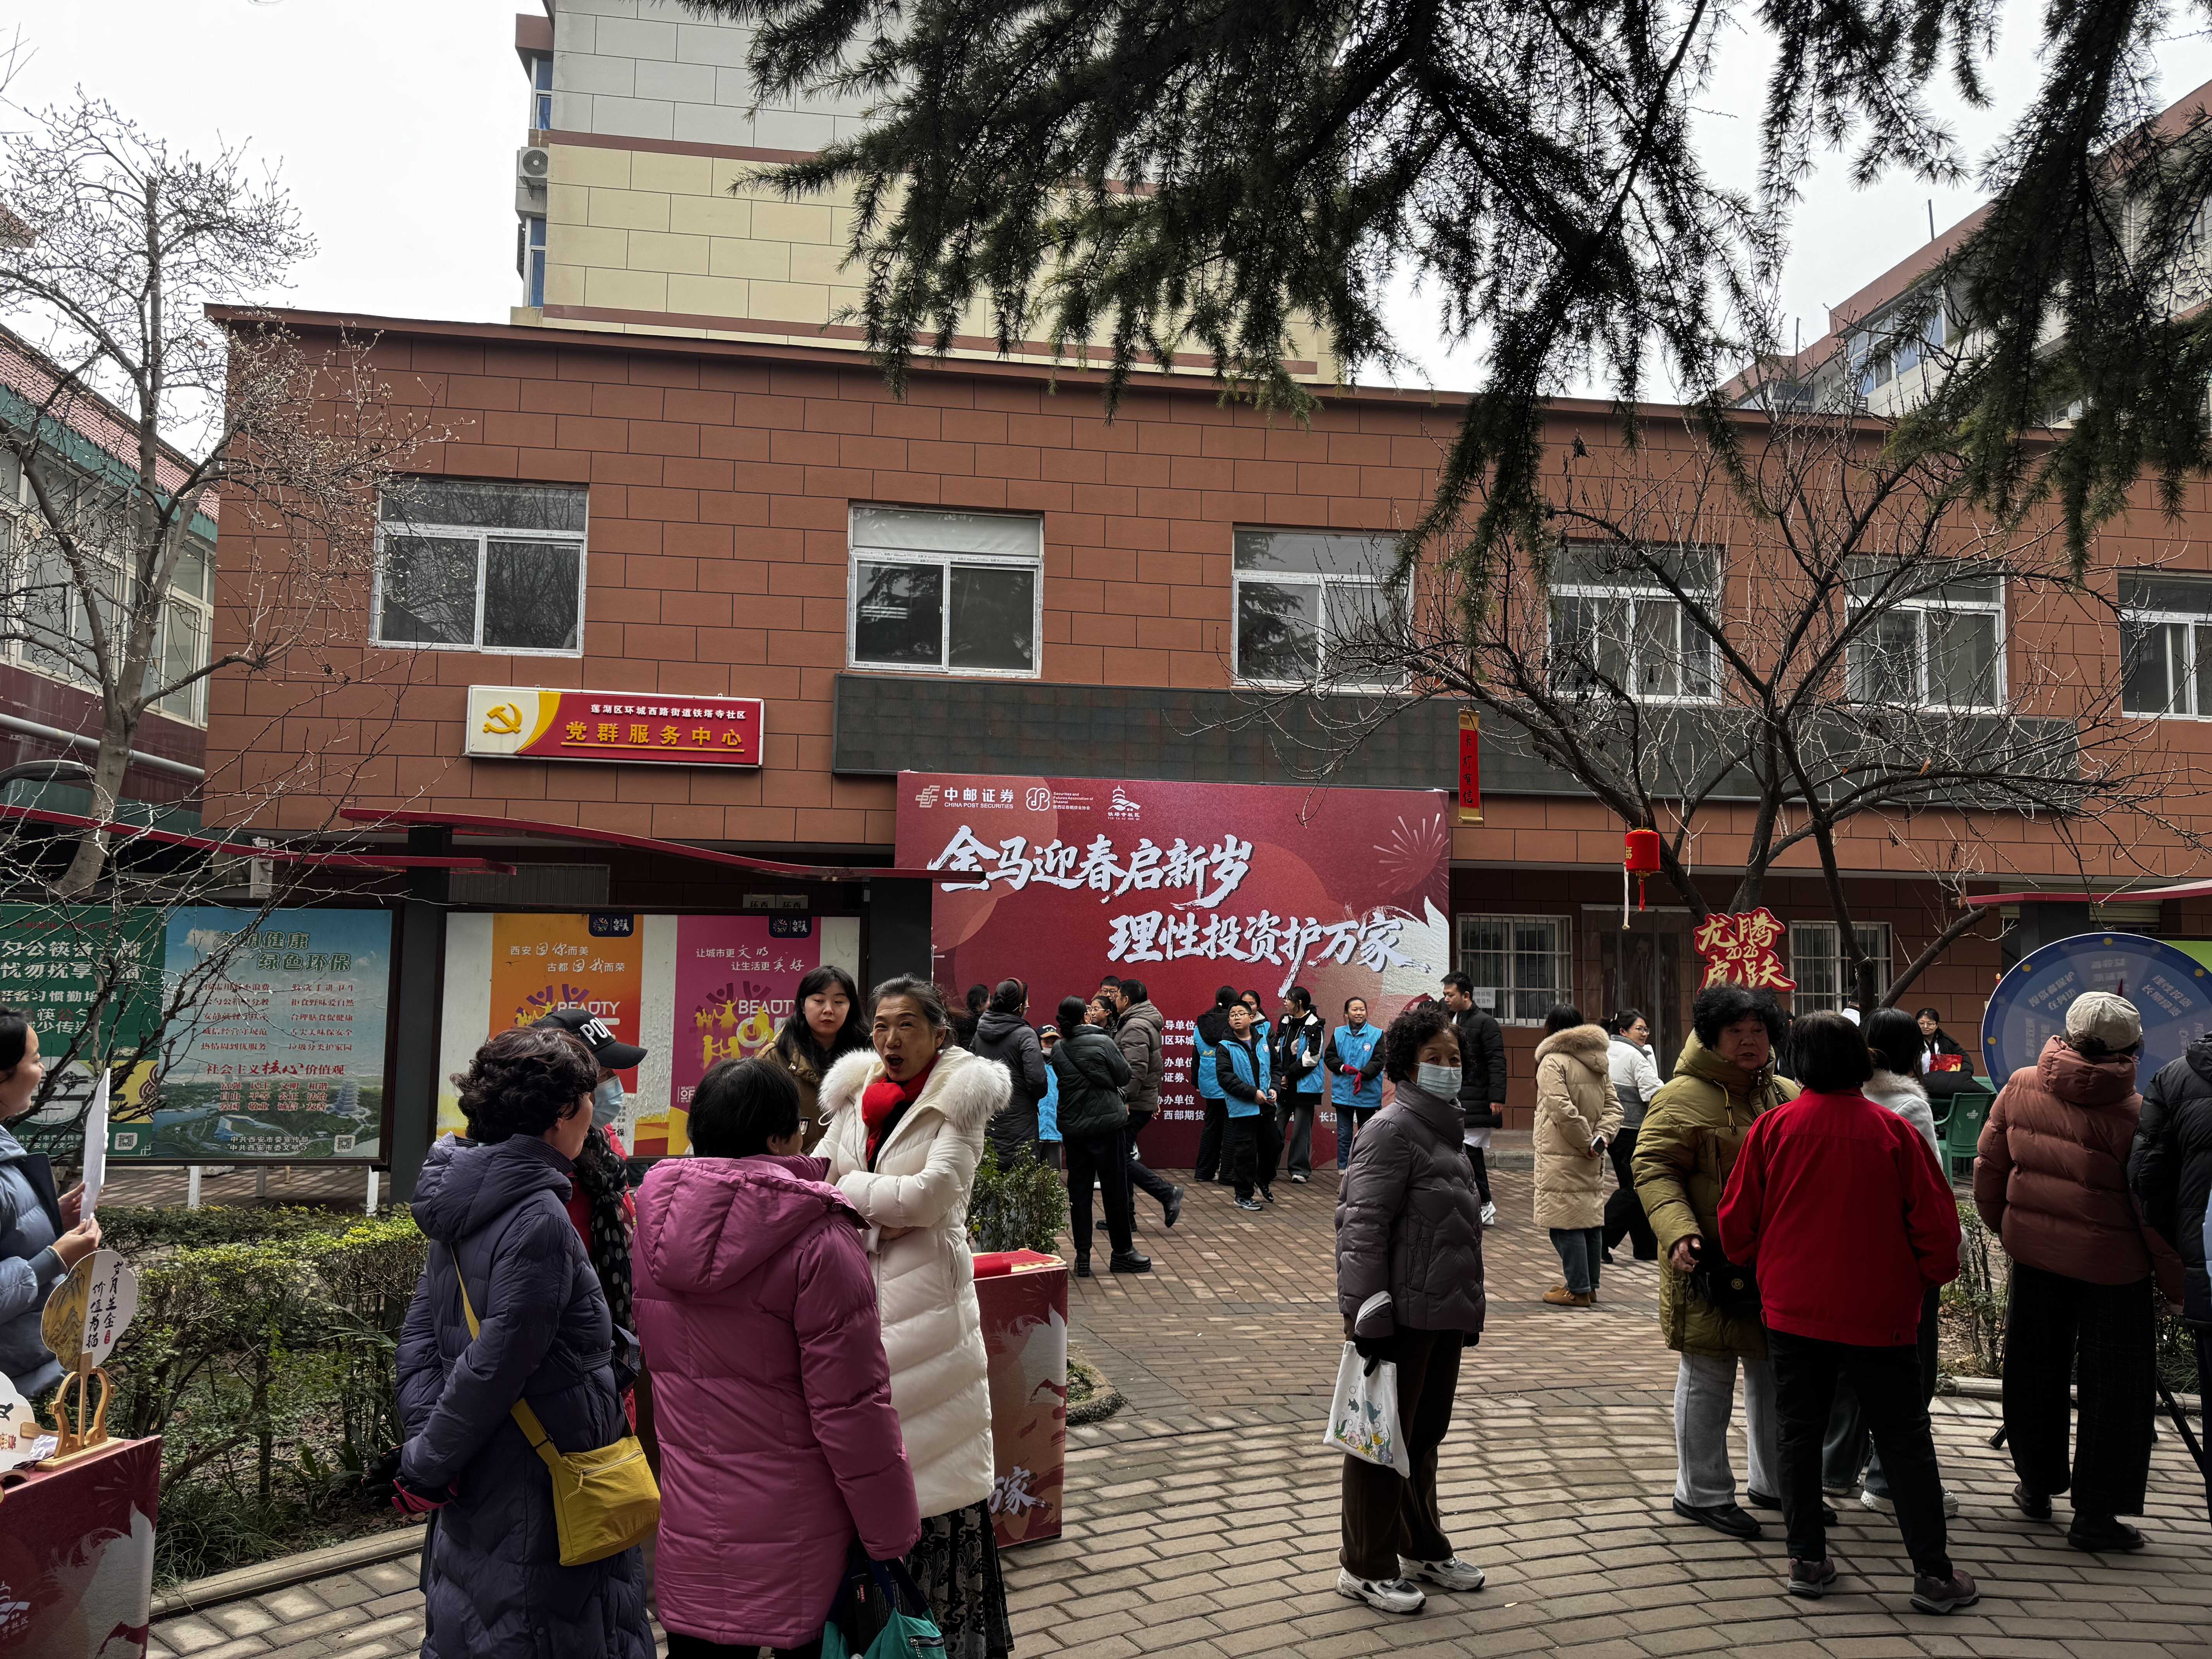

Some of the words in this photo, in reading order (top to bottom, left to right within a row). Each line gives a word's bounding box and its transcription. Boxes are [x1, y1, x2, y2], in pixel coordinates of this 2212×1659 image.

[590, 704, 746, 720] 莲湖区环城西路街道铁塔寺社区
[565, 721, 742, 746] 党群服务中心
[944, 787, 1014, 803] 中邮证券
[929, 824, 1253, 911] 金马迎春启新岁
[1697, 912, 1780, 951] 龙腾
[213, 931, 309, 950] 文明健康
[510, 942, 589, 956] 西安因你而美
[696, 945, 768, 959] 让城市更文明
[1107, 909, 1430, 998] 理性投资护万家
[1726, 945, 1759, 960] 2026
[257, 953, 350, 972] 绿色环保
[547, 958, 625, 973] 古都因我而荣
[731, 957, 805, 973] 让生活更美好
[1, 962, 139, 979] 忧勿扰享福
[1704, 954, 1792, 989] 虎跃
[738, 1000, 796, 1014] BEAUT
[1162, 1020, 1195, 1030] 导单位
[289, 1043, 352, 1051] 垃圾分类护家园
[1161, 1035, 1194, 1045] 区环城
[206, 1060, 345, 1075] 社会主义核心价值观
[1161, 1073, 1188, 1083] 证券、
[221, 1082, 242, 1090] 富强
[250, 1082, 270, 1090] 民主
[280, 1082, 300, 1090] 文明
[309, 1082, 328, 1091] 和谐
[220, 1092, 240, 1101] 自由
[249, 1092, 270, 1101] 平等
[278, 1092, 299, 1101] 公正
[307, 1092, 327, 1101] 法治
[681, 1090, 695, 1099] OF
[219, 1102, 240, 1111] 爱国
[248, 1102, 269, 1111] 敬业
[278, 1102, 298, 1111] 诚信
[306, 1102, 326, 1111] 友善
[1164, 1110, 1205, 1120] 西部期货
[1319, 1111, 1337, 1122] 长江
[103, 1261, 123, 1329] 岁月生金
[86, 1281, 105, 1348] 价值为锚
